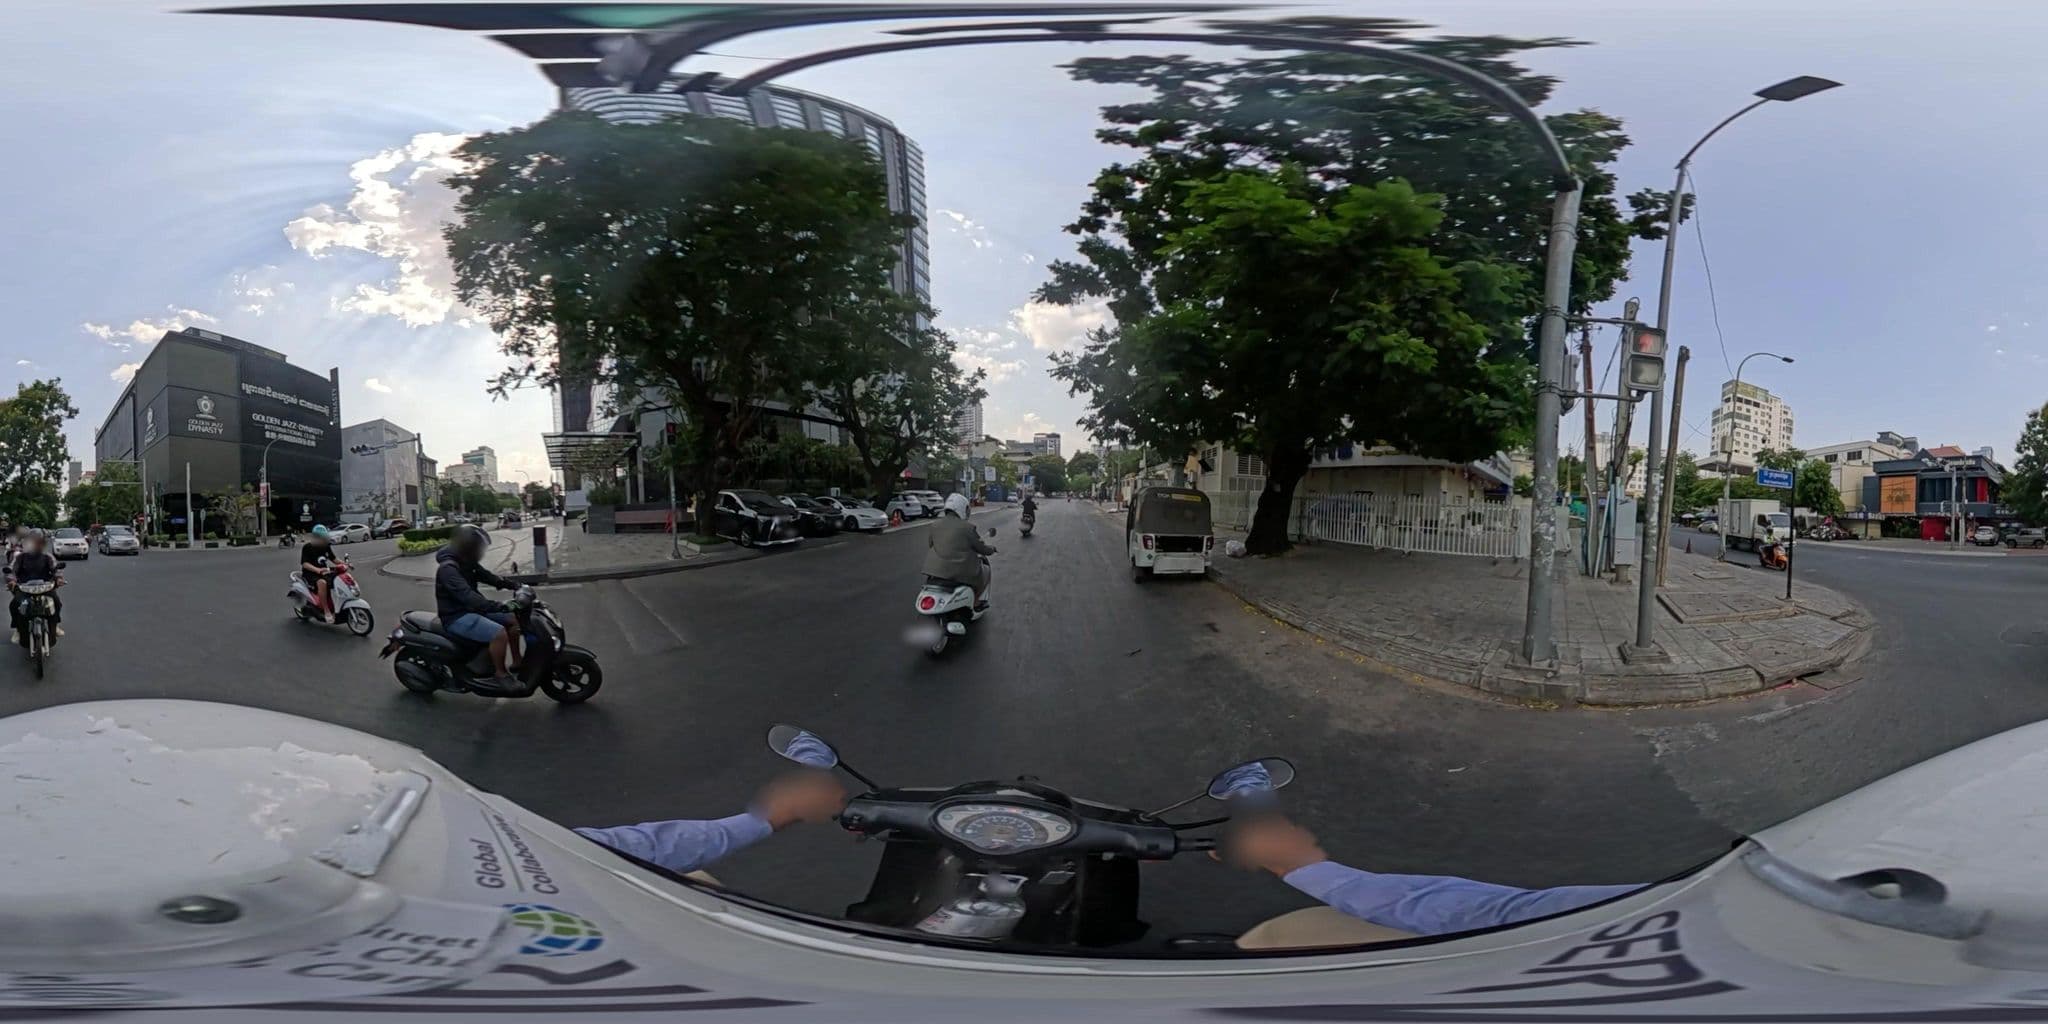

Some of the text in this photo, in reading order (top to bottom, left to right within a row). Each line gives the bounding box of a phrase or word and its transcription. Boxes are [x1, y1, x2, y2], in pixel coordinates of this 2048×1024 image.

[252, 413, 280, 425] GOLDEN
[187, 423, 224, 435] DYNASTY
[469, 837, 506, 889] Global
